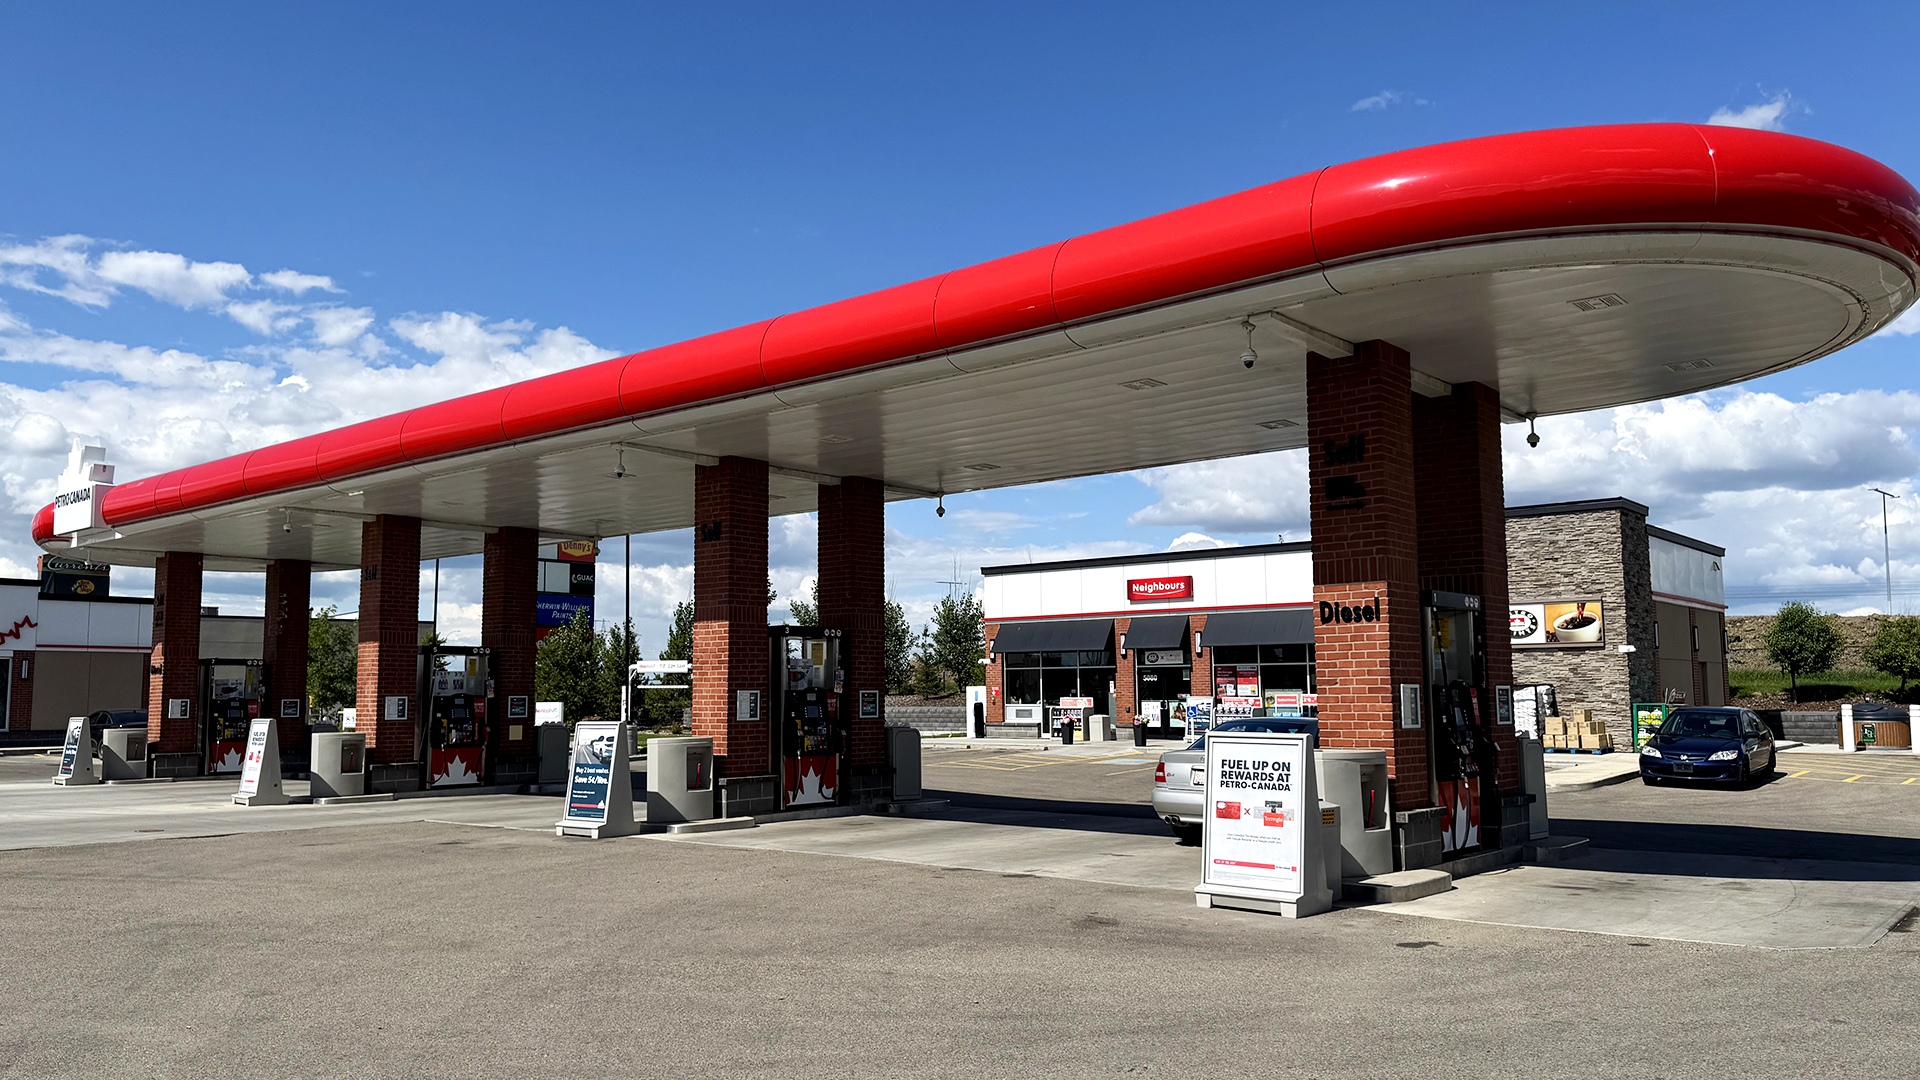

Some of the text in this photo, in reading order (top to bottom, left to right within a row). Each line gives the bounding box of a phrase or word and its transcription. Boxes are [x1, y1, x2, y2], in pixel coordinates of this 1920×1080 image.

[1323, 434, 1365, 466] Self
[1132, 582, 1185, 593] Neighbours
[1319, 597, 1380, 625] Diesel
[1221, 759, 1291, 772] FUEL UP ON
[1221, 770, 1291, 783] REWARDS AT
